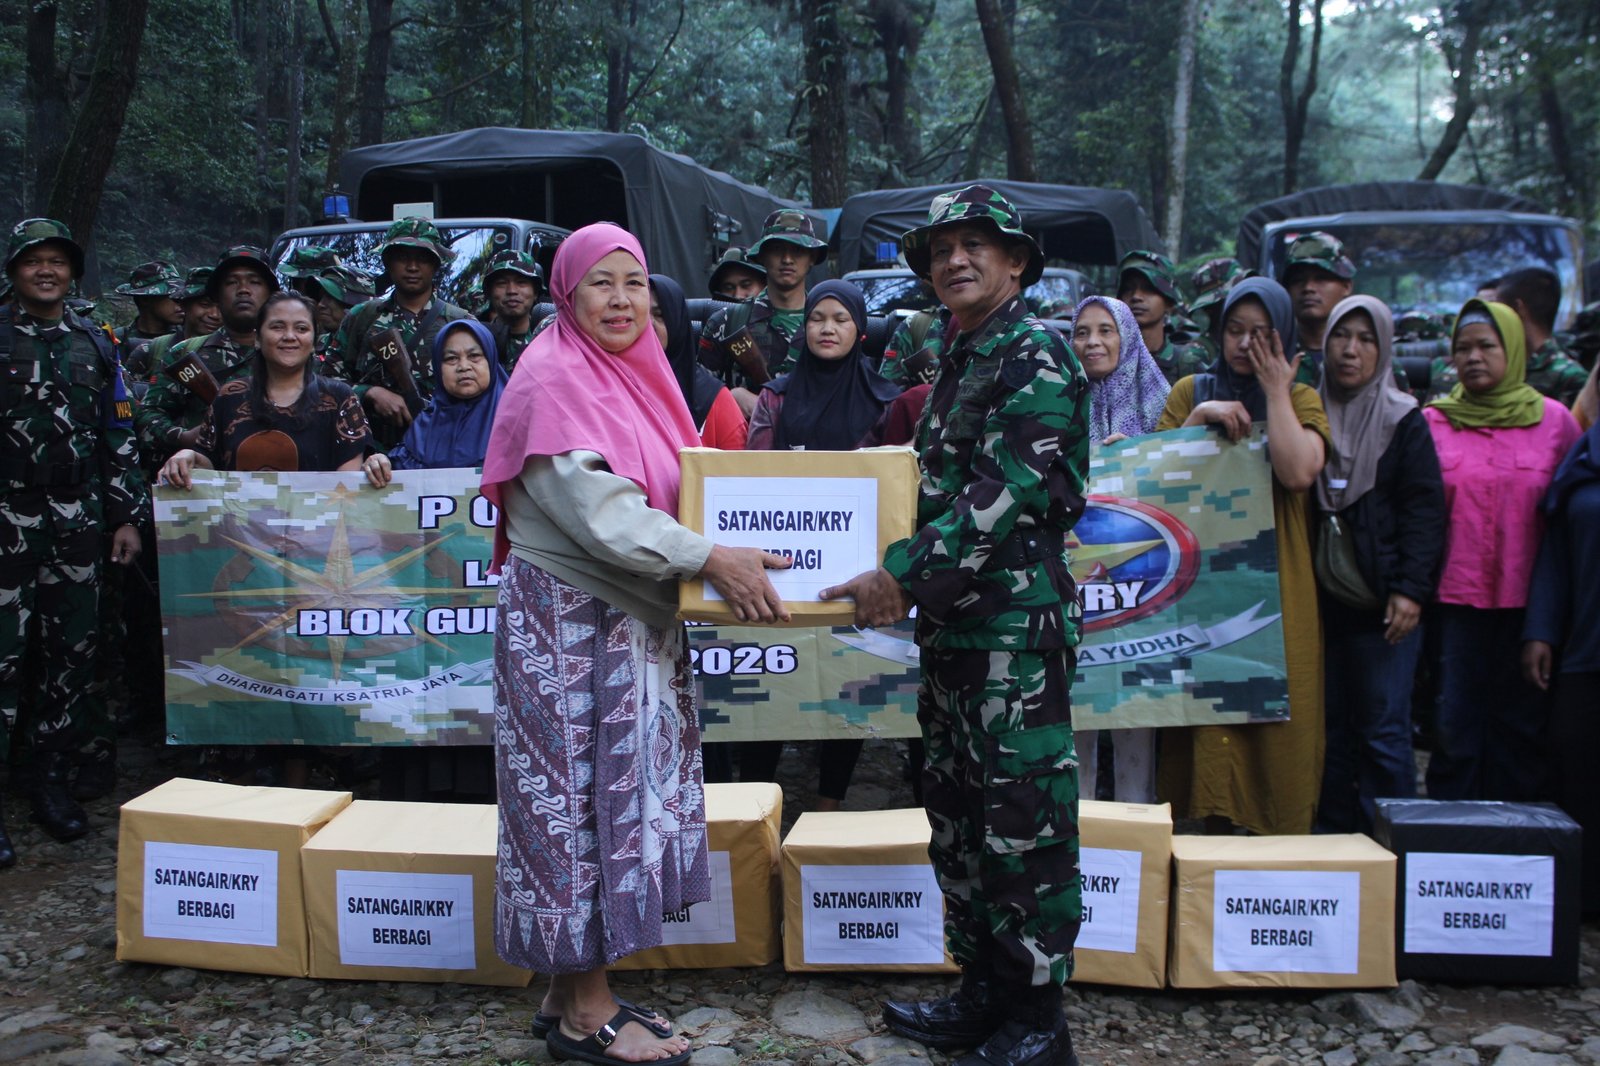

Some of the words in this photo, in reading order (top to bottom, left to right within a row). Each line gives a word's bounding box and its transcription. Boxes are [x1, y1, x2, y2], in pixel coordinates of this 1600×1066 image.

[378, 340, 398, 360] 92
[178, 363, 202, 383] 160
[718, 510, 853, 532] SATANGAIR/KRY
[297, 608, 416, 637] BLOK
[1100, 632, 1195, 660] YUDHA
[216, 673, 323, 702] DHARMAGATI
[333, 686, 413, 703] KSATRIA
[421, 671, 464, 693] JAYA
[155, 868, 259, 892] SATANGAIR/KRY
[812, 891, 923, 910] SATANGAIR/KRY
[1418, 881, 1533, 901] SATANGAIR/KRY
[178, 899, 235, 920] BERBAGI
[348, 896, 455, 918] SATANGAIR/KRY
[1226, 898, 1338, 917] SATANGAIR/KRY
[838, 921, 899, 940] BERBAGI
[1443, 912, 1506, 930] BERBAGI
[372, 927, 432, 946] BERBAGI
[1251, 928, 1314, 947] BERBAGI
